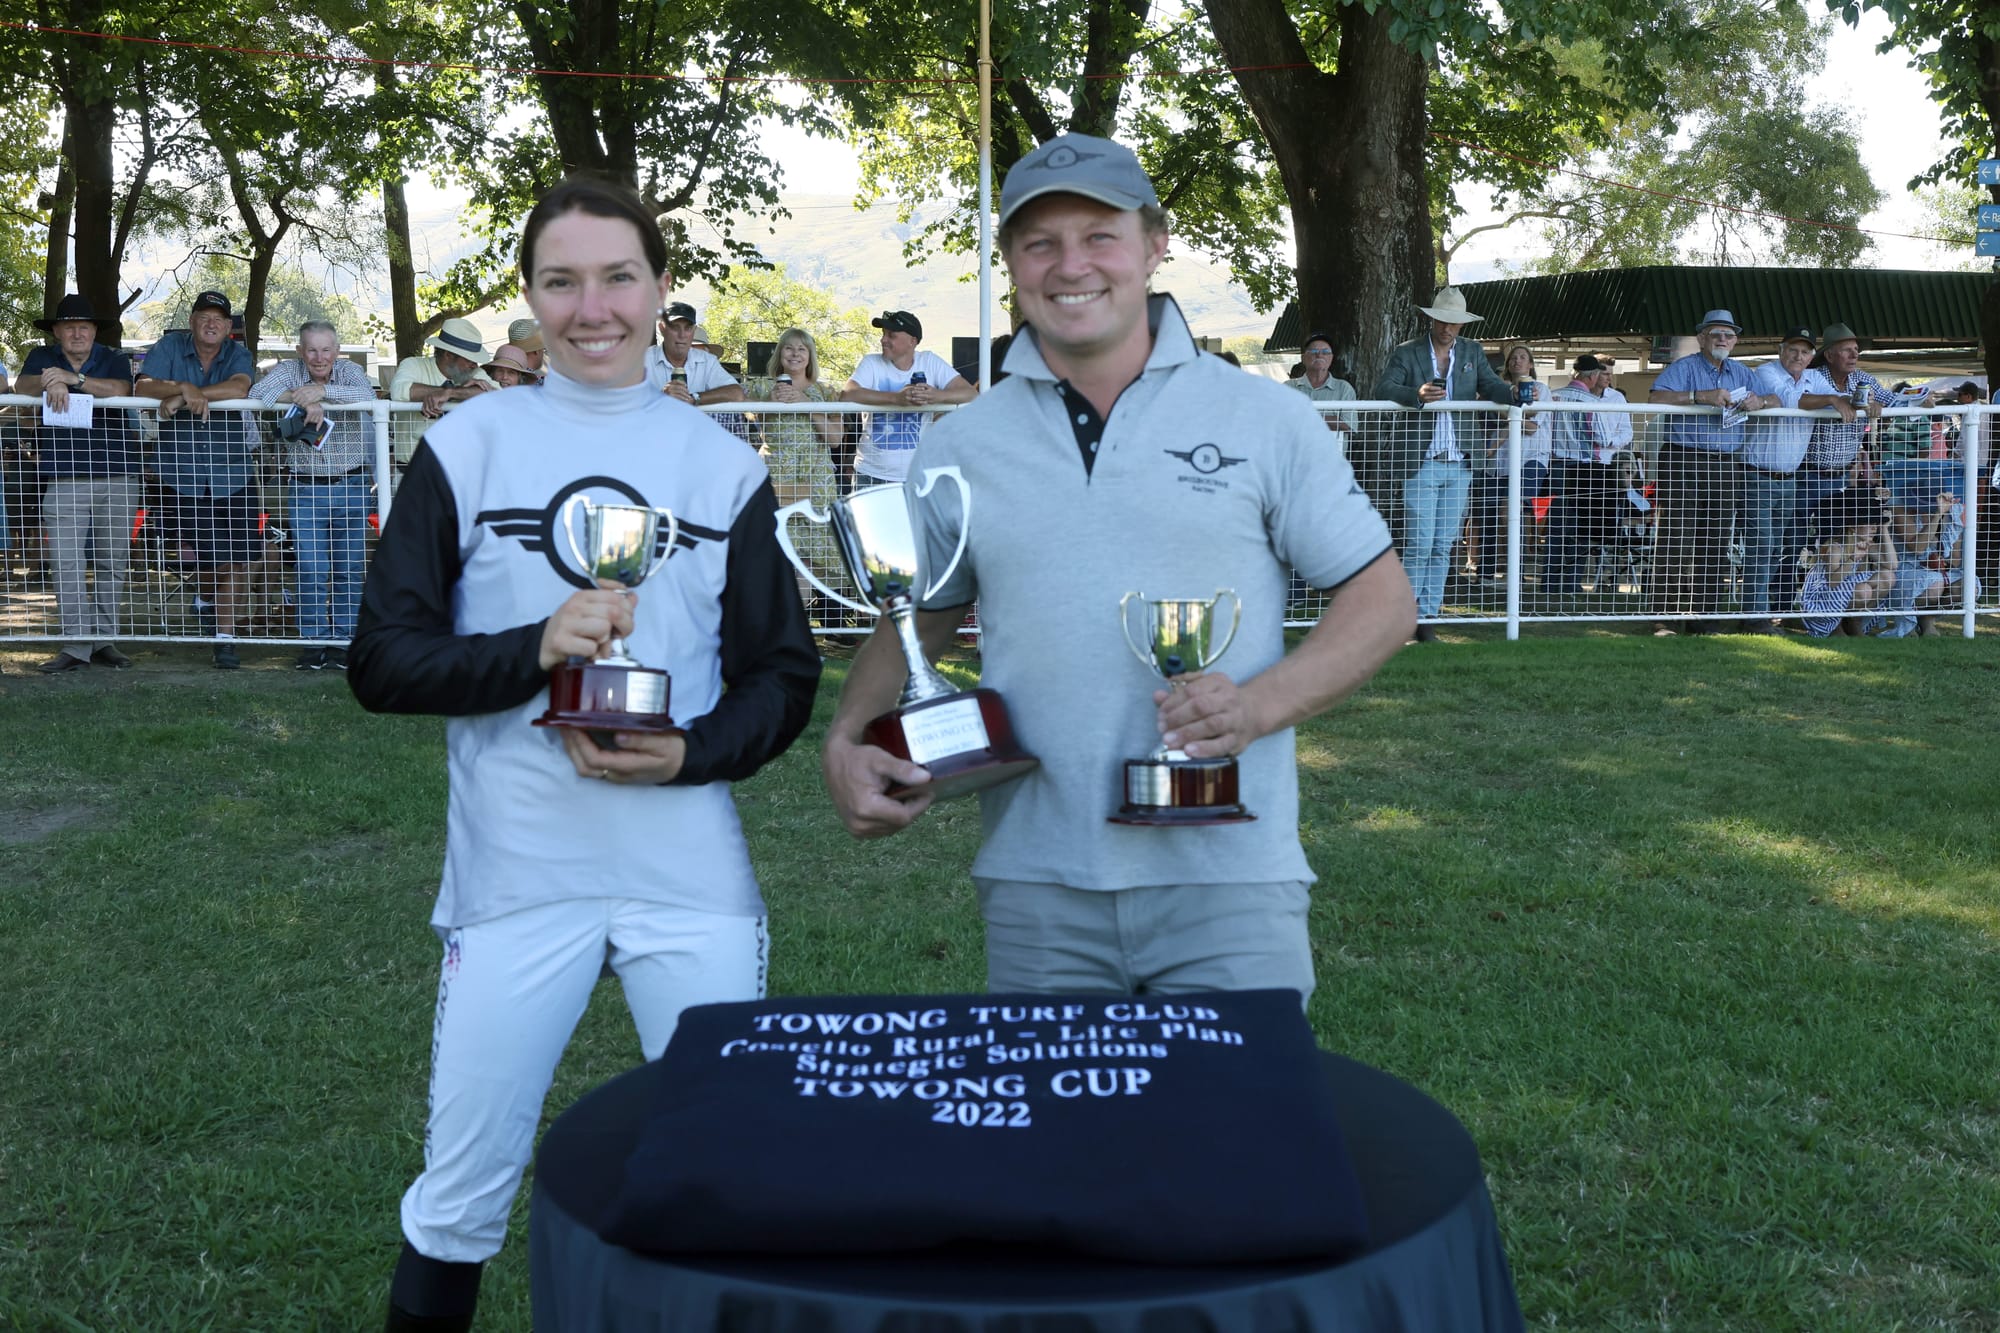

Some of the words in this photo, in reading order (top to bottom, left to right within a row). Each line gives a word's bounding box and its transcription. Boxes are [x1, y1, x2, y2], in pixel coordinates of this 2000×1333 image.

[753, 1009, 948, 1035] TOWONG
[969, 1004, 1085, 1025] TURF
[1104, 1003, 1220, 1022] CLUB
[892, 1029, 995, 1057] Rural
[1060, 1024, 1139, 1042] Life
[1160, 1022, 1244, 1045] Plan
[797, 1053, 967, 1079] Strategic
[987, 1041, 1169, 1064] Solutions
[794, 1074, 1026, 1100] TOWONG
[1050, 1068, 1151, 1098] CUP
[932, 1101, 1032, 1127] 2022
